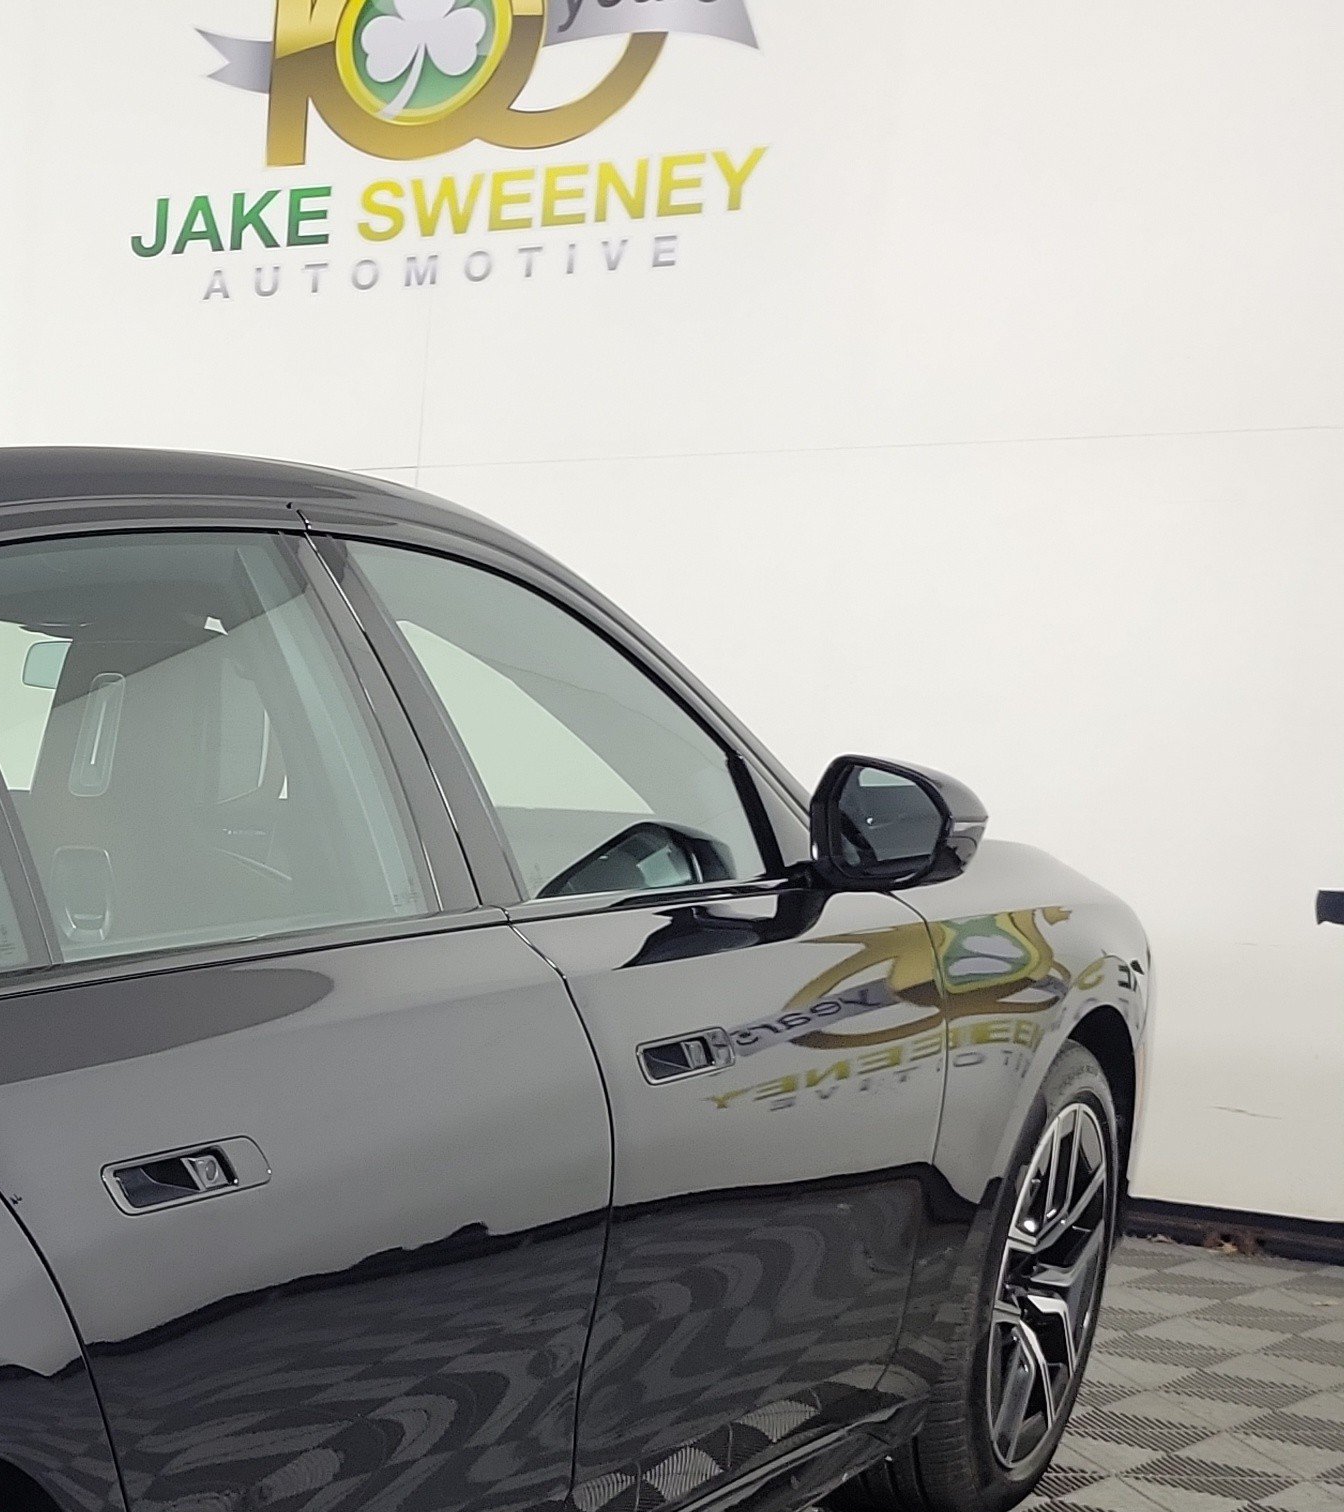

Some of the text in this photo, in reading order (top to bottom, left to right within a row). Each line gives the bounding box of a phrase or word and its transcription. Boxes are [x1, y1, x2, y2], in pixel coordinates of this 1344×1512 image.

[130, 147, 769, 258] JAKE SWEENEY
[202, 235, 679, 301] AUTOMOTIVE
